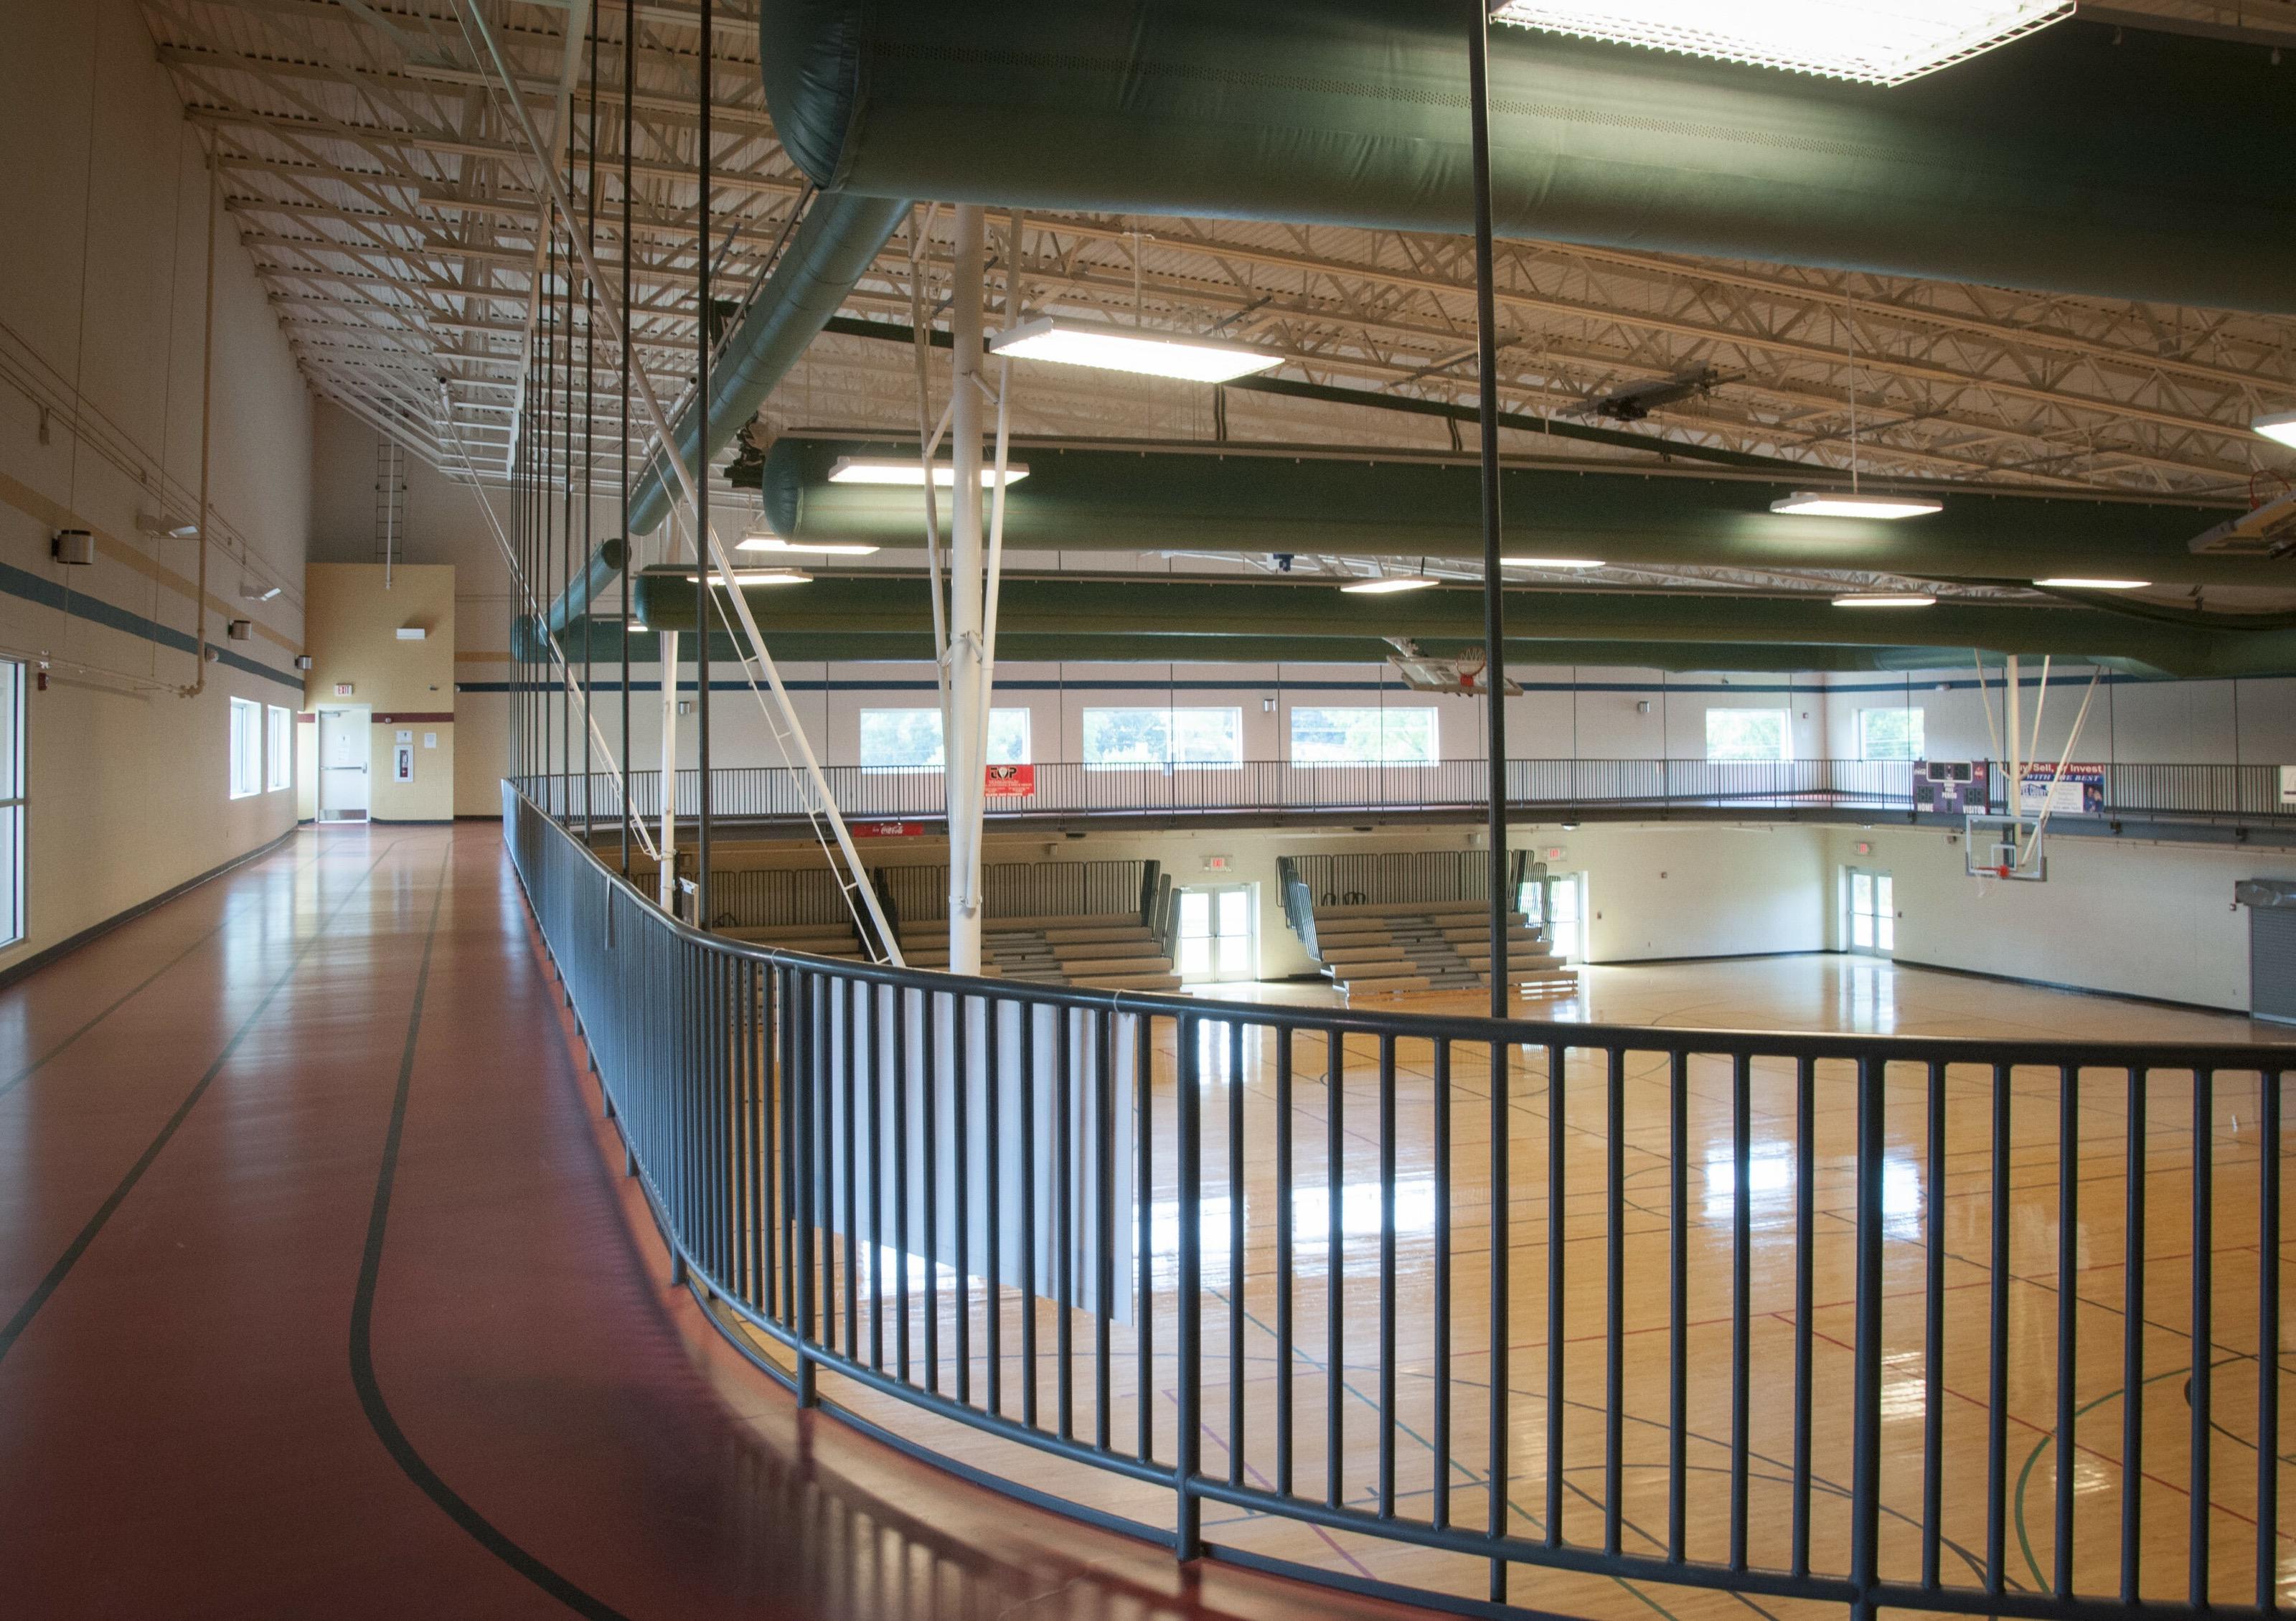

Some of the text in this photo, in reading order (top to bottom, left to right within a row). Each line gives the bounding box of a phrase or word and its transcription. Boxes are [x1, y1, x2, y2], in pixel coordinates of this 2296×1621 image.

[2071, 763, 2102, 773] Invest
[1917, 803, 1934, 812] HOME
[1962, 805, 1986, 814] VISITOR
